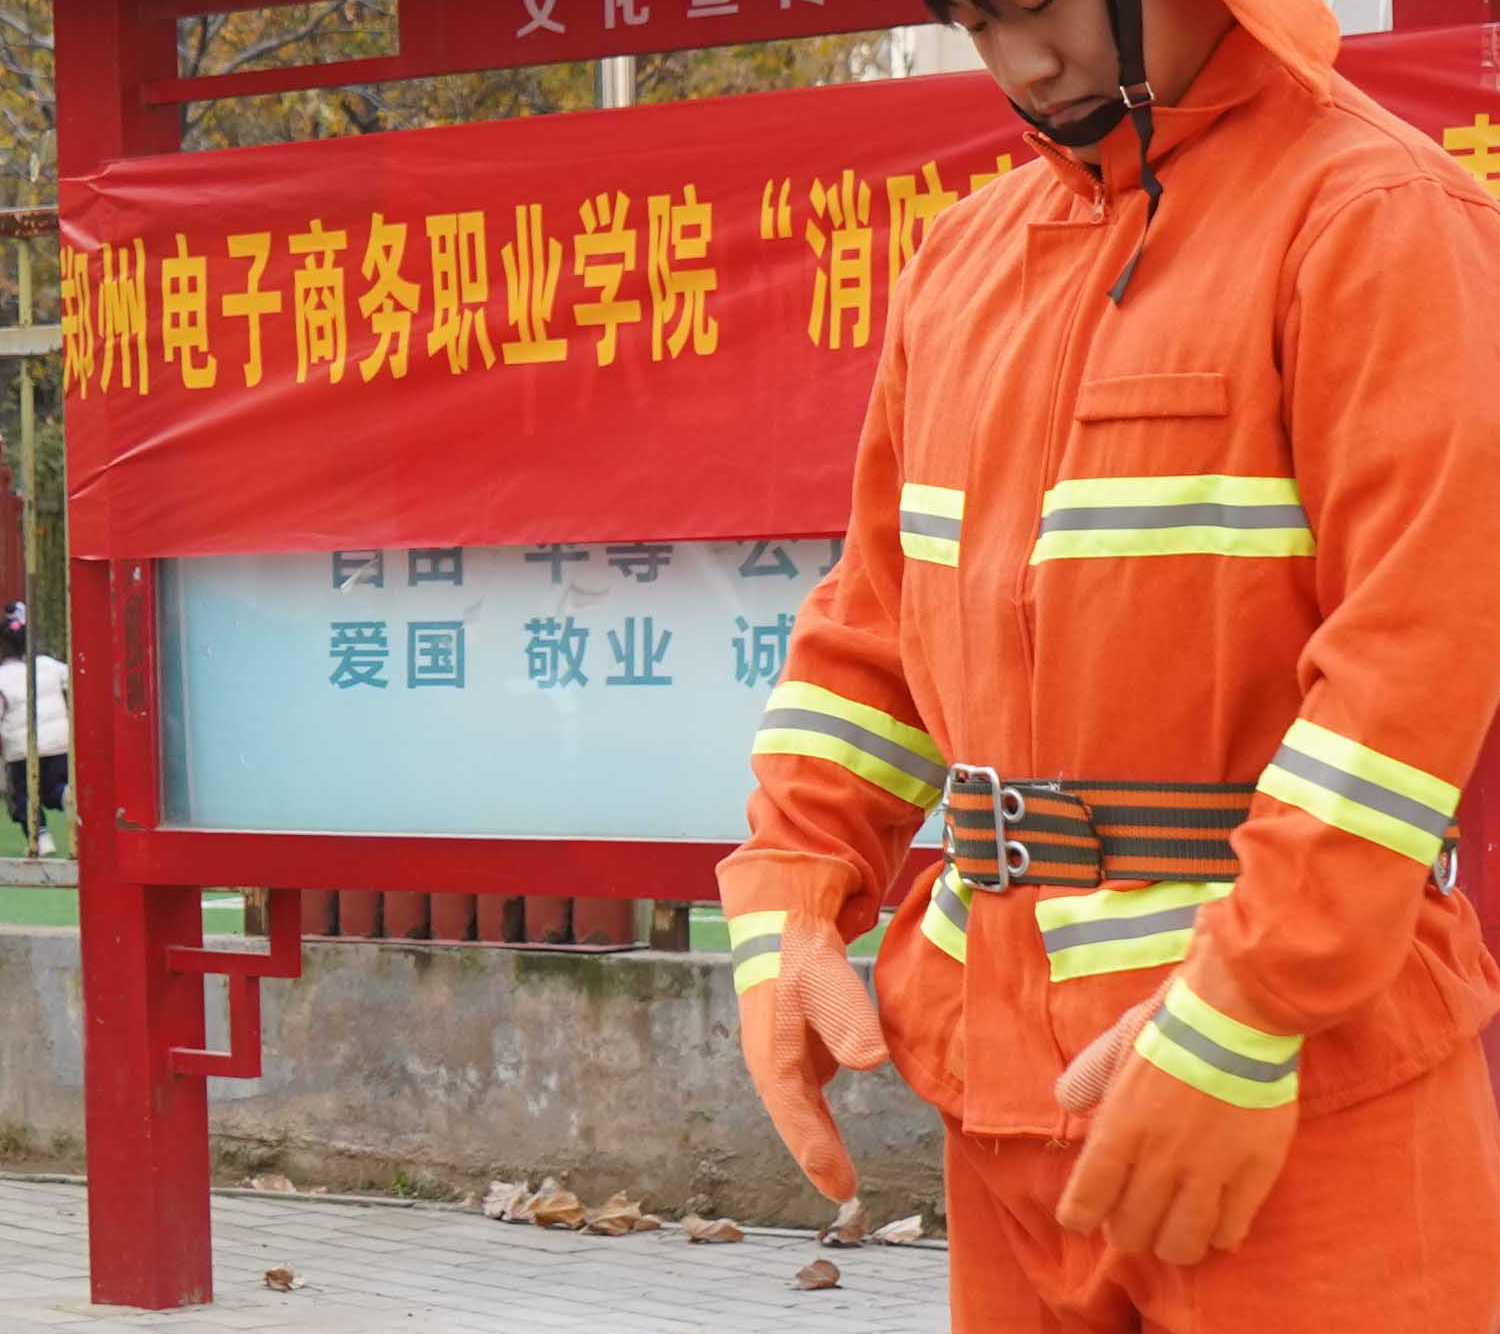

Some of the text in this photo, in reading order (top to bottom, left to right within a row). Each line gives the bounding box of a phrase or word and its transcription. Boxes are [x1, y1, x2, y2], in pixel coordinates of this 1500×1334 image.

[60, 154, 1015, 400] 郑州电子商务职业学院“消
[329, 620, 465, 689] 爱国
[524, 616, 673, 689] 敬业
